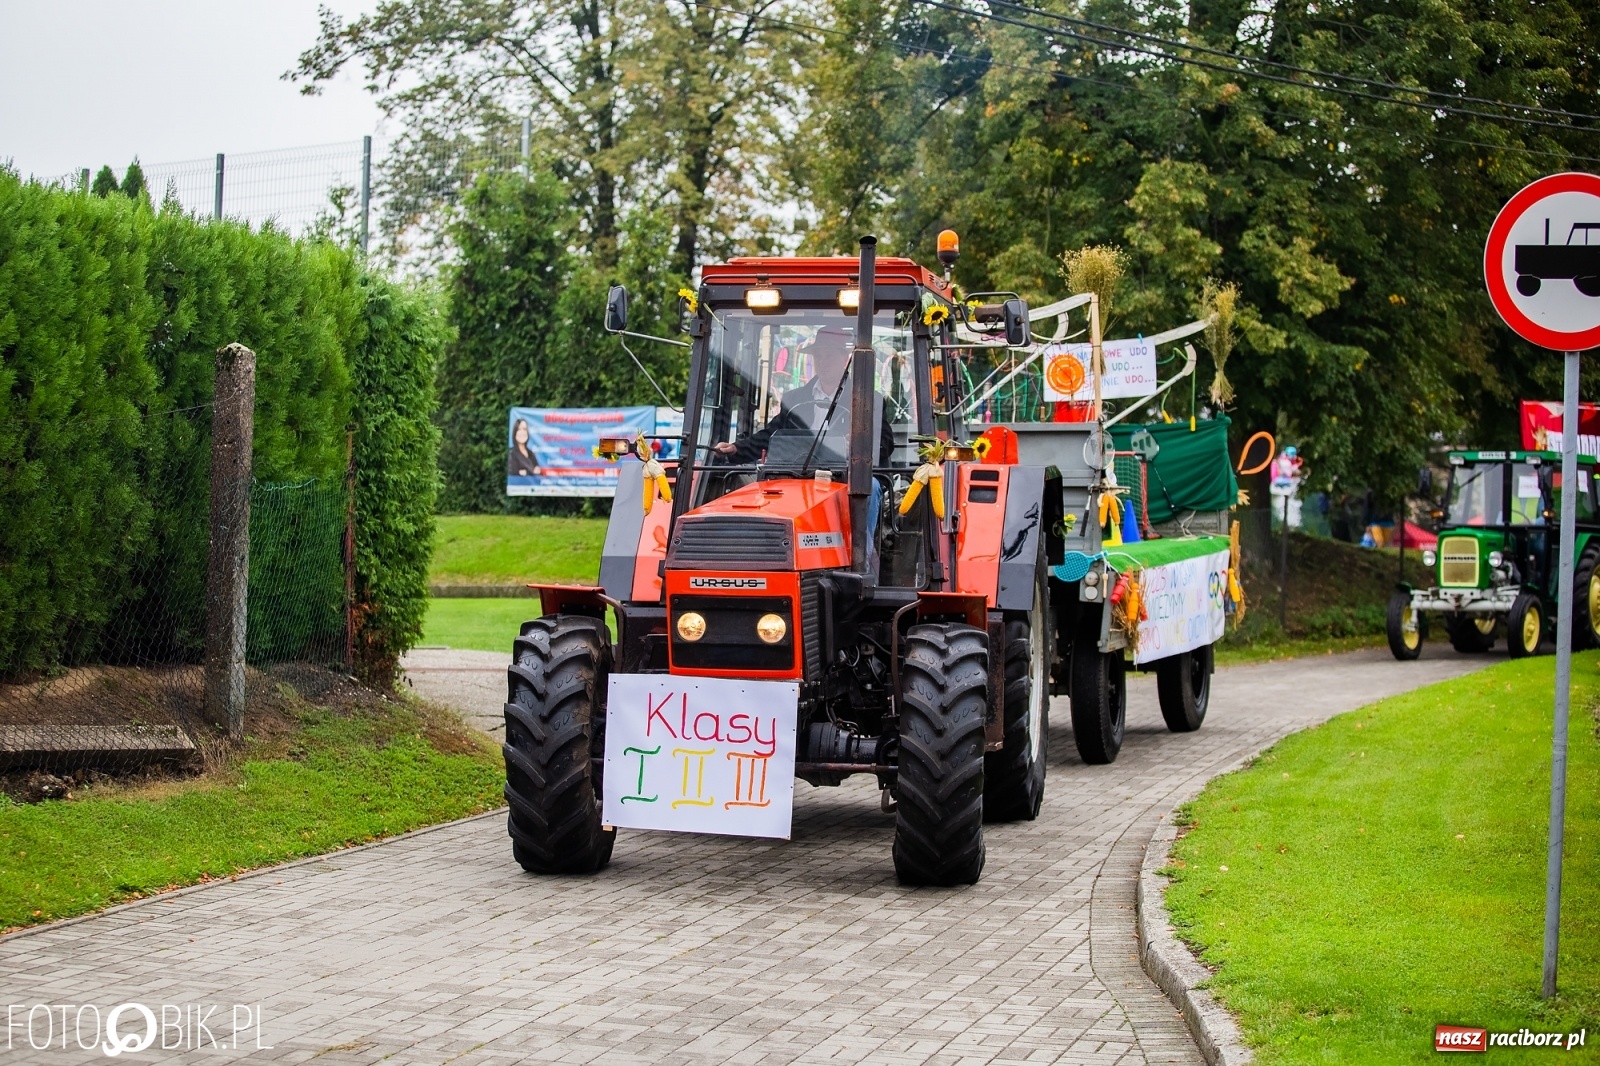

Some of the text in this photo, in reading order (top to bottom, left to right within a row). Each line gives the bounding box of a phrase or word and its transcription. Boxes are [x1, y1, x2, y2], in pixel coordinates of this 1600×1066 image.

[1129, 346, 1148, 356] UDO
[692, 578, 766, 588] URSUS
[646, 691, 777, 757] Klasy
[620, 745, 773, 810] I II III
